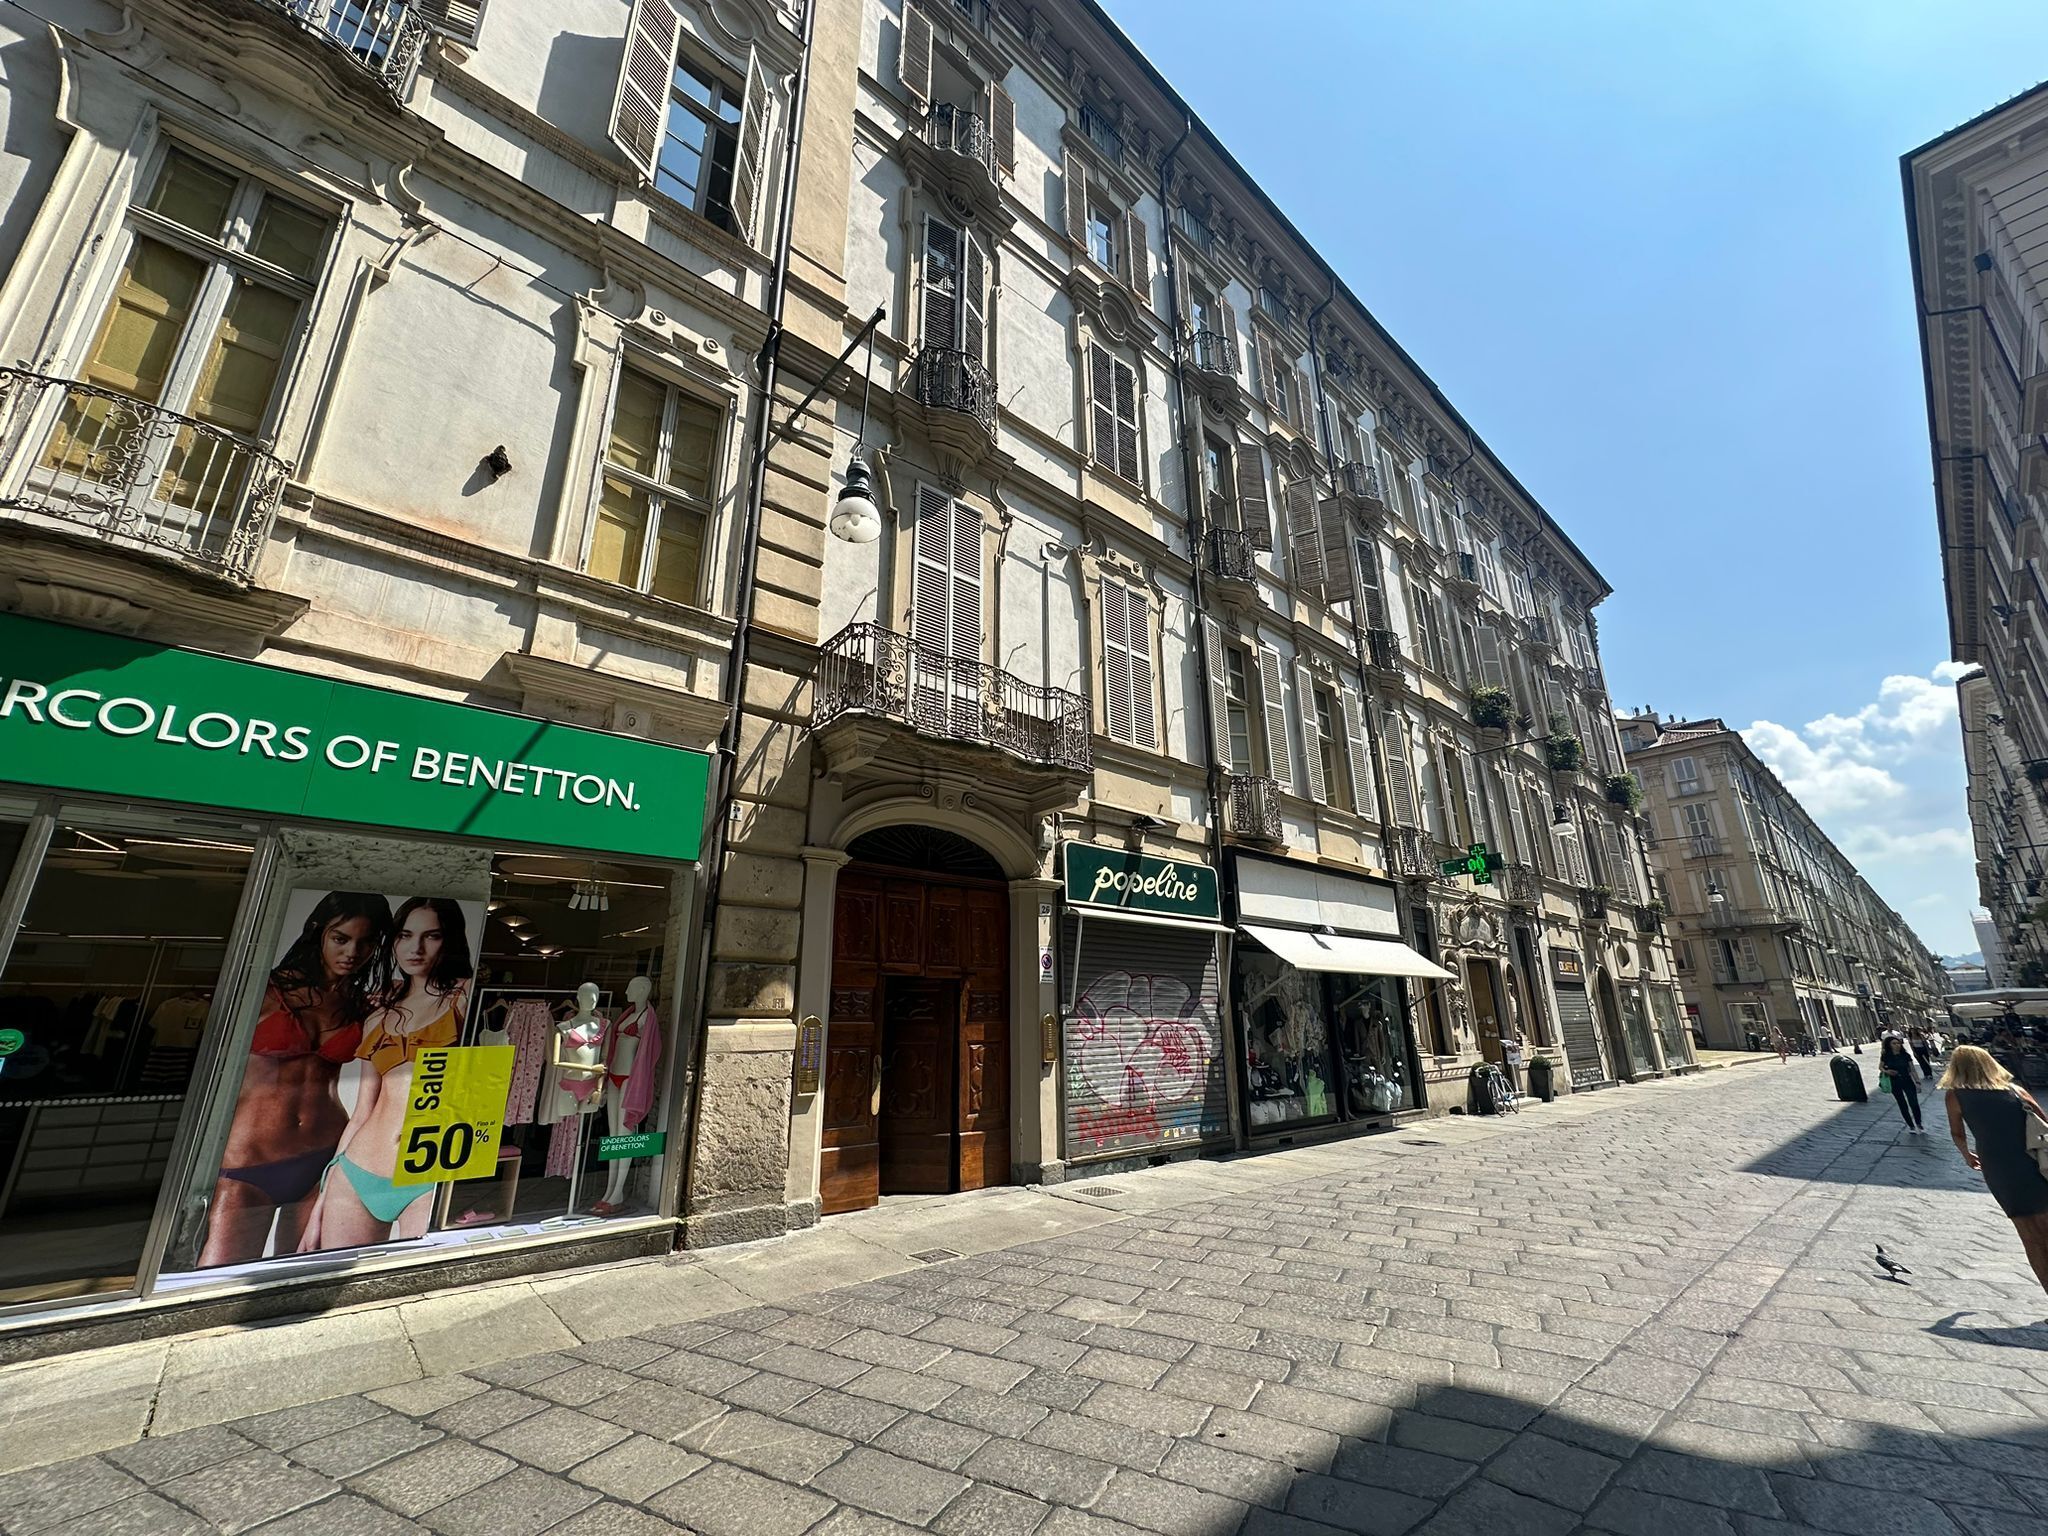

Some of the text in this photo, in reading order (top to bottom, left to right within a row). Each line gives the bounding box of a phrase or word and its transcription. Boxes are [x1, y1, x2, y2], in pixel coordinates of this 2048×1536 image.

[0, 677, 641, 811] RCOLORS OF BENETTON.
[1089, 863, 1198, 906] popeline
[414, 1052, 449, 1111] Saldi
[600, 1144, 611, 1152] OF
[601, 1134, 650, 1145] UNDERCOLORS
